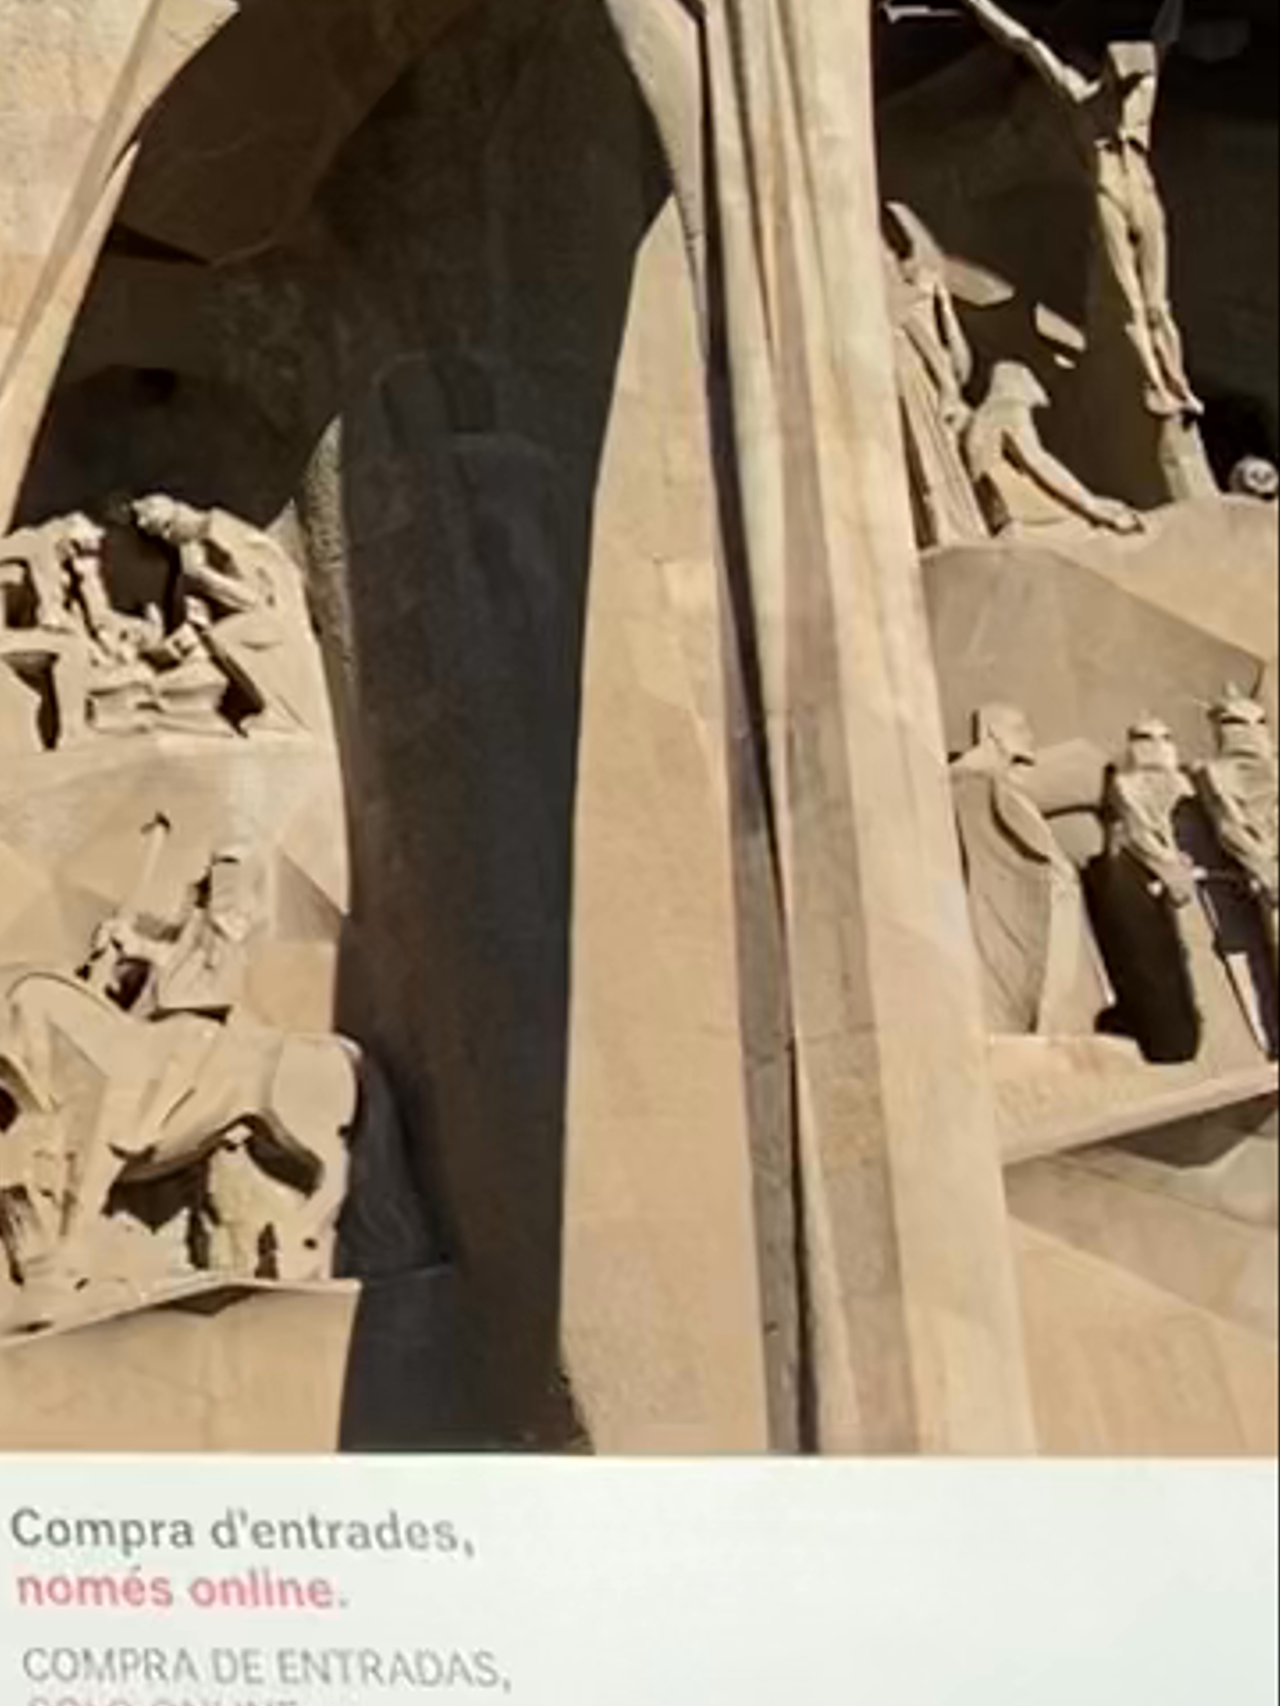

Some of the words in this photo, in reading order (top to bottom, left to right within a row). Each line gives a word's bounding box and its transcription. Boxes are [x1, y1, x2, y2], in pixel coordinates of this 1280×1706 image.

[10, 1507, 195, 1557] Compra
[209, 1507, 475, 1558] d'entrades,
[16, 1565, 175, 1608] només
[187, 1567, 351, 1609] online.
[23, 1648, 200, 1684] COMPRA
[211, 1648, 265, 1685] DE
[277, 1648, 512, 1693] ENTRADAS,
